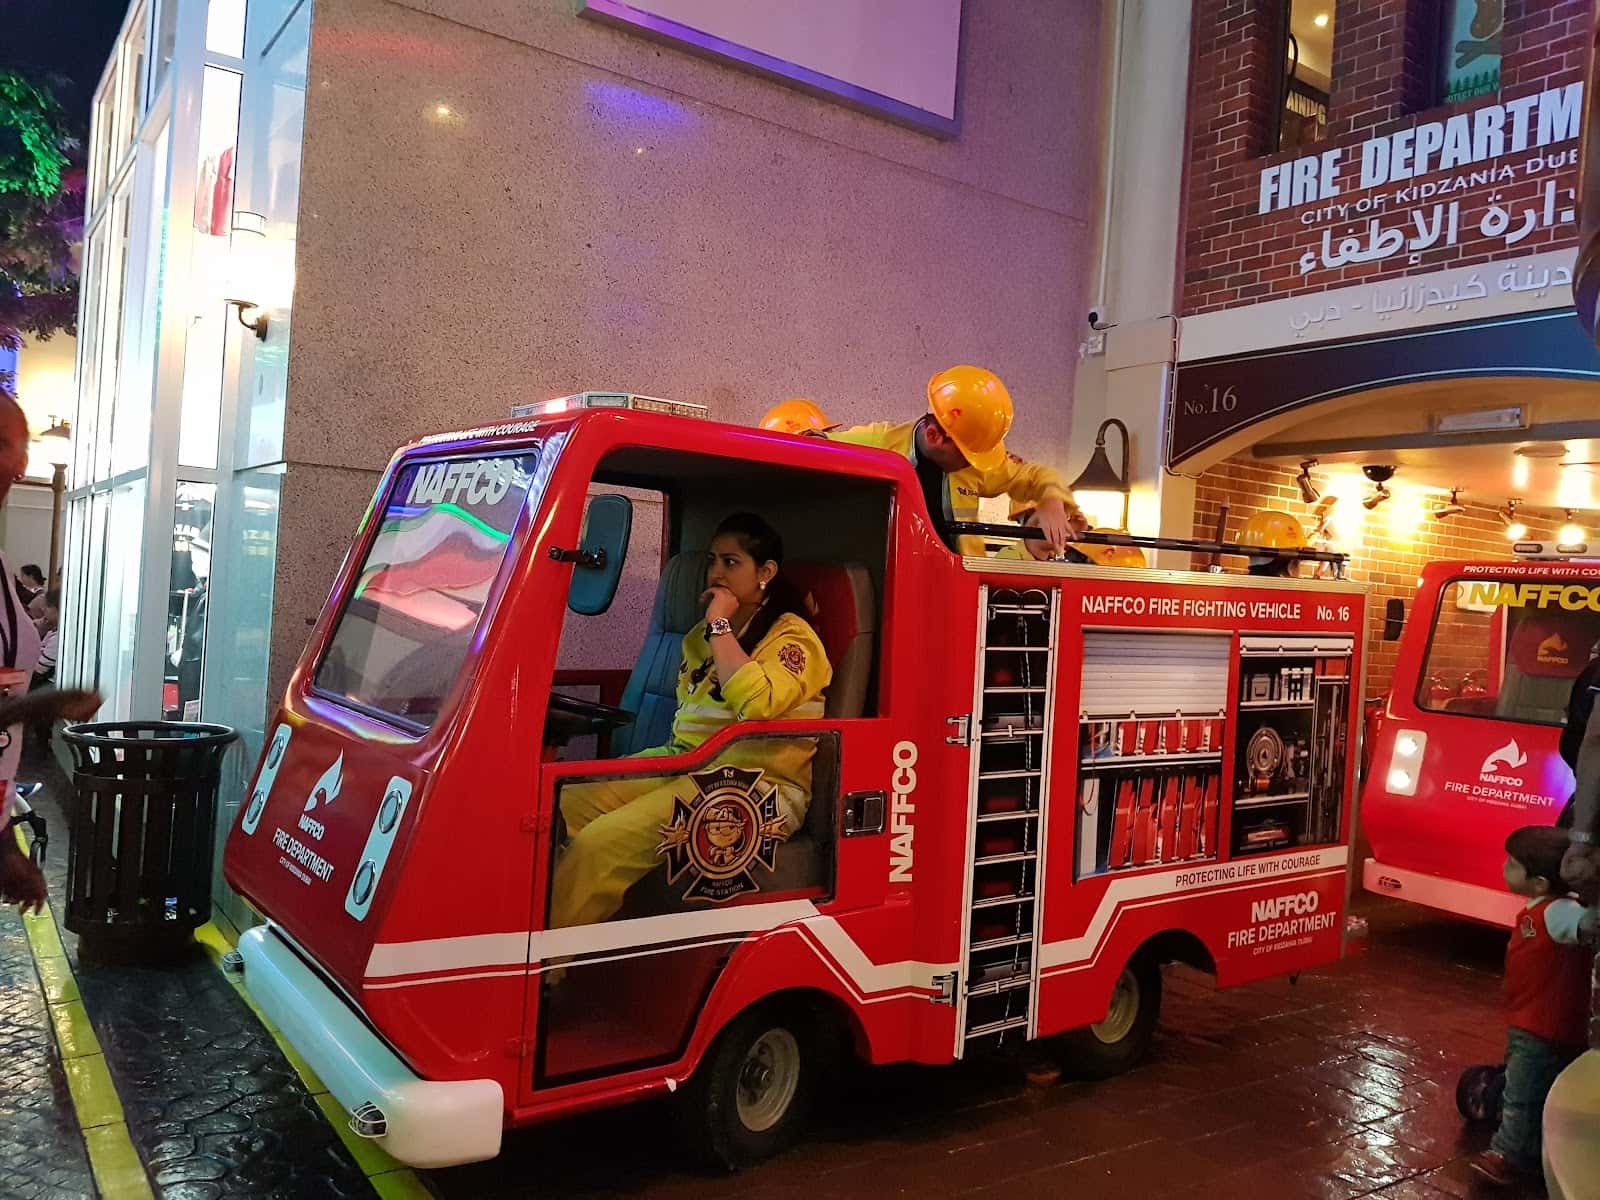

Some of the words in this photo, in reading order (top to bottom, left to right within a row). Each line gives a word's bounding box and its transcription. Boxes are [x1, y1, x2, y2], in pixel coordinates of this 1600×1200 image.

[1286, 90, 1326, 125] AINING
[1259, 149, 1341, 215] FIRE
[1360, 81, 1584, 189] DEPARTM
[1301, 202, 1349, 225] CITY
[1356, 194, 1387, 212] OF
[1396, 165, 1515, 204] KIDZANIA
[1526, 149, 1577, 174] DUB
[1300, 201, 1459, 275] الإطفاء
[1373, 274, 1487, 320] كيدزانيا
[1500, 264, 1572, 298] دينة
[1290, 303, 1341, 338] دبي
[406, 459, 516, 505] NAFFCO
[1463, 565, 1526, 574] PROTECTING
[1528, 567, 1549, 575] LIFE
[1552, 567, 1579, 575] WITH
[1081, 595, 1145, 615] NAFFCO
[1149, 598, 1180, 616] FIRE
[1183, 599, 1246, 618] FIGHTING
[1249, 601, 1300, 619] VEHICLE
[1317, 605, 1334, 621] No.
[1338, 606, 1349, 621] 16
[1444, 781, 1470, 794] FIRE
[1472, 785, 1556, 807] DEPARTMENT
[1480, 773, 1523, 787] NAFFCO
[298, 813, 325, 841] NAFFCO
[889, 740, 918, 883] NAFFCO
[272, 827, 290, 851] FIRE
[286, 837, 334, 883] DEPARTMENT
[1175, 867, 1235, 888] PROTECTING
[1237, 864, 1256, 878] LIFE
[1259, 860, 1279, 874] WITH
[1281, 855, 1321, 870] COURAGE
[1251, 890, 1318, 923] NAFFCO
[1227, 927, 1256, 949] FIRE
[1258, 911, 1336, 943] DEPARTMENT
